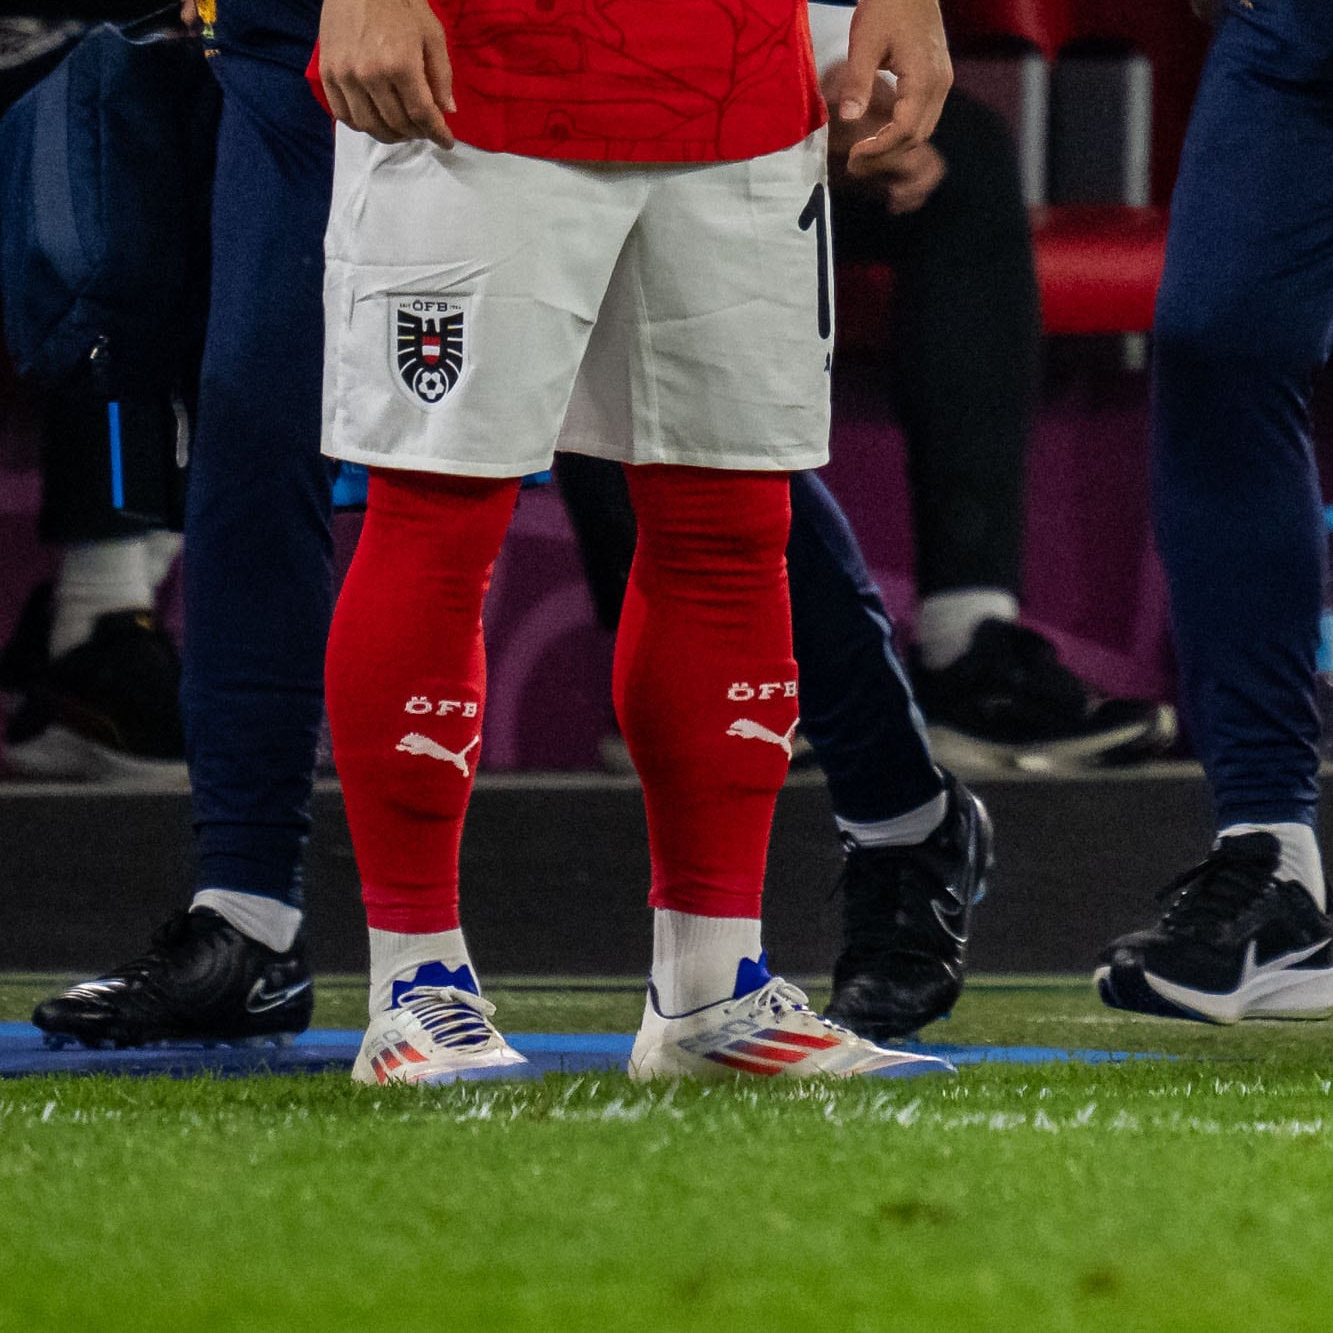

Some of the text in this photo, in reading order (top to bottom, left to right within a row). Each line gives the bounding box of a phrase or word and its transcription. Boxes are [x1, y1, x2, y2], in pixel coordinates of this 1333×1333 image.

[412, 299, 448, 312] ÖFB
[727, 680, 797, 701] ÖFB
[404, 695, 477, 718] ÖFB
